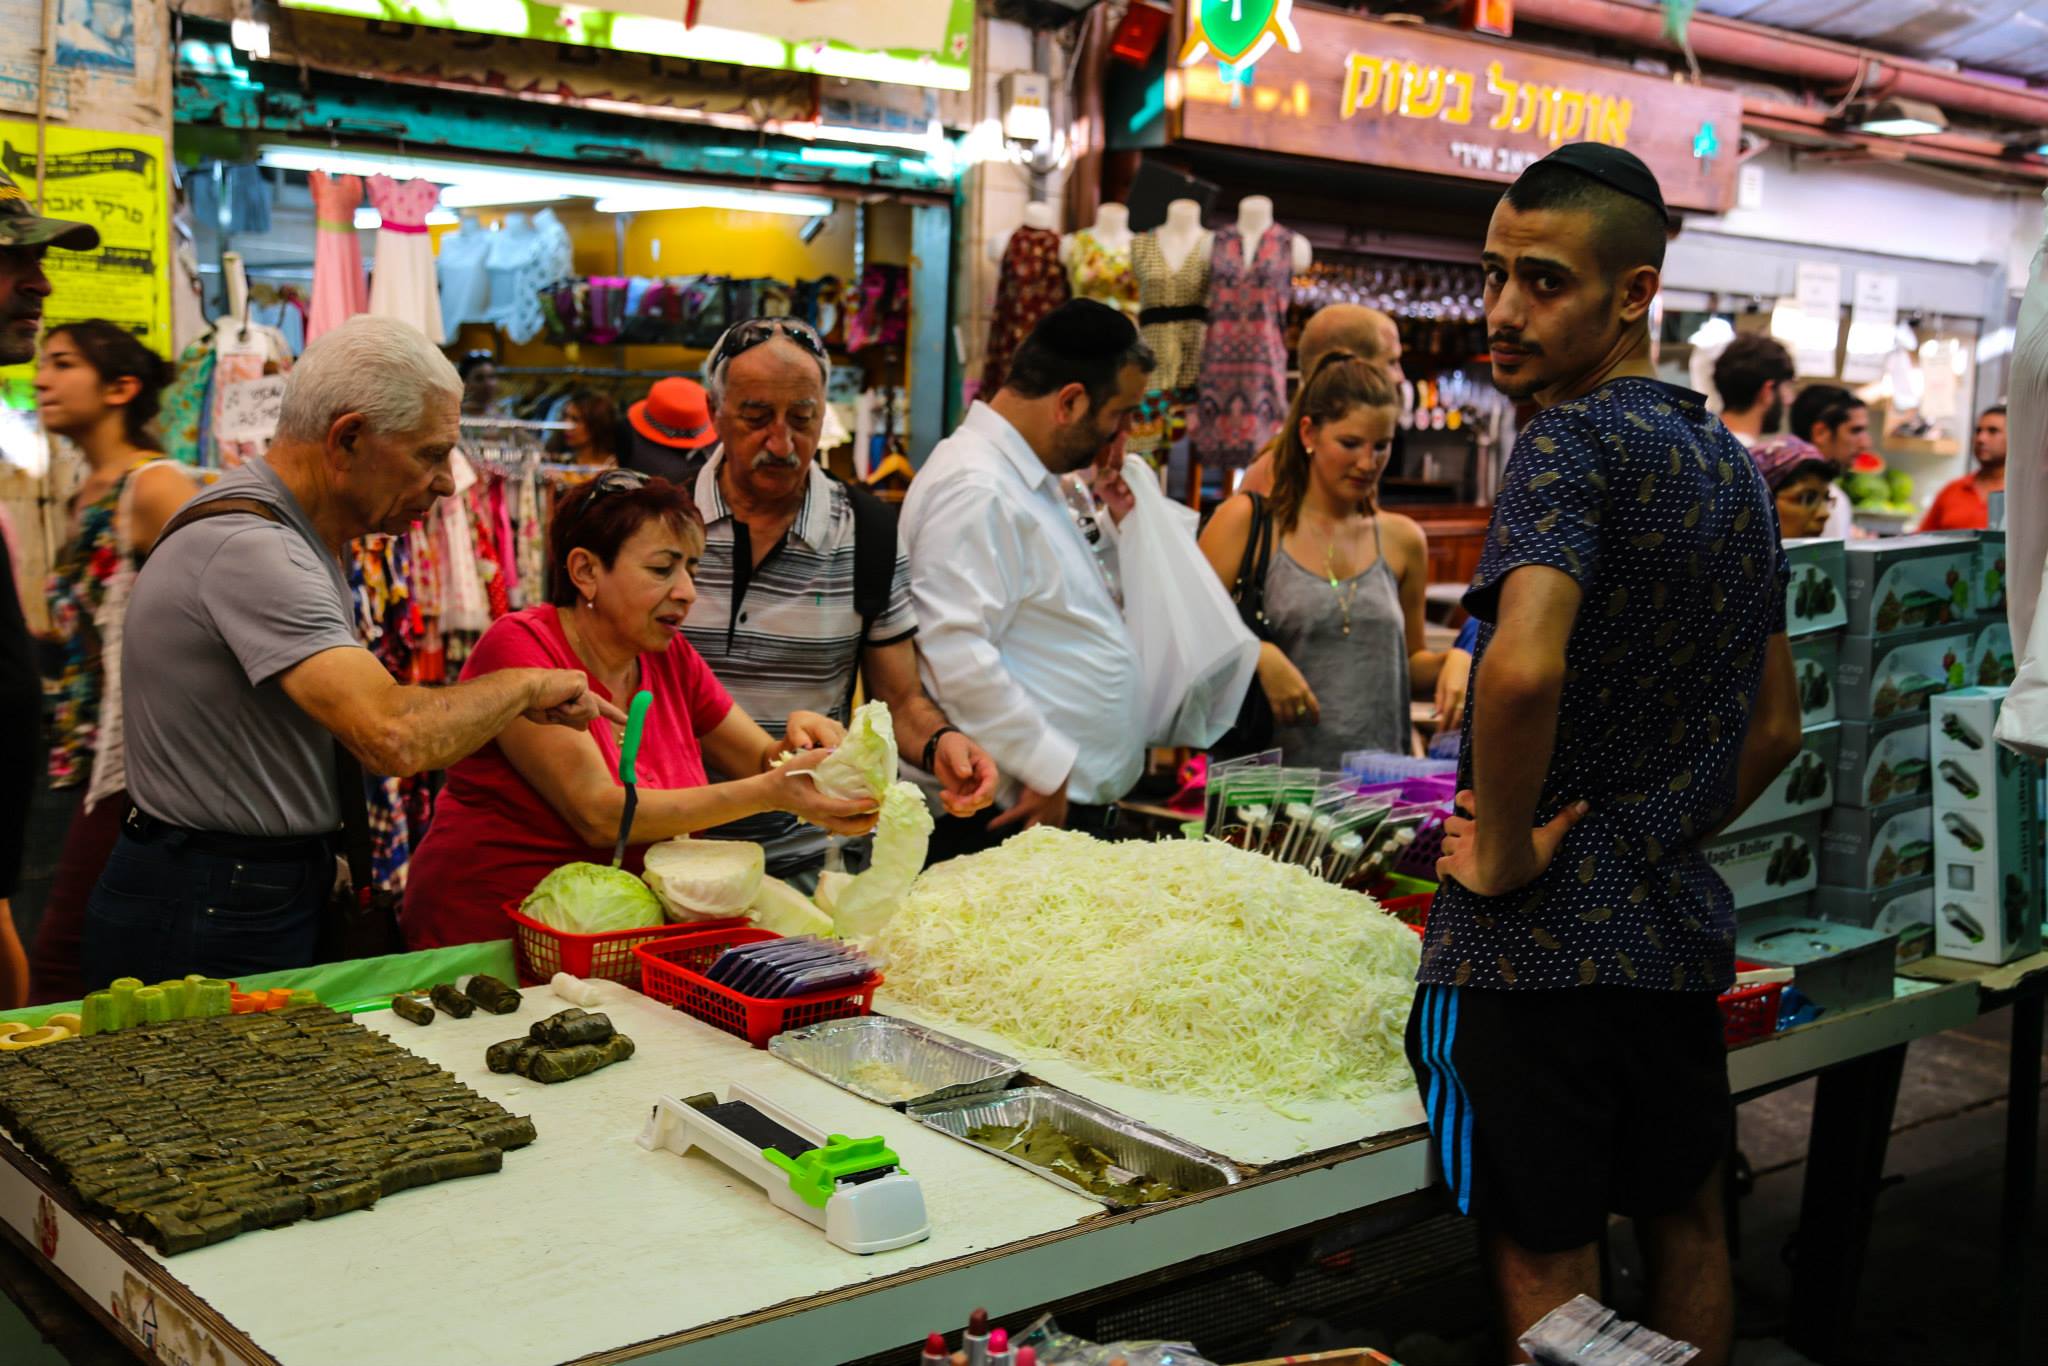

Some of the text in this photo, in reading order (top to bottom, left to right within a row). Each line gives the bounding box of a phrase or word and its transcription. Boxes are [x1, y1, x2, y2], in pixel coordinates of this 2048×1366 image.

[1340, 50, 1632, 148] אוקונל בשוק
[1739, 840, 1774, 857] Roller
